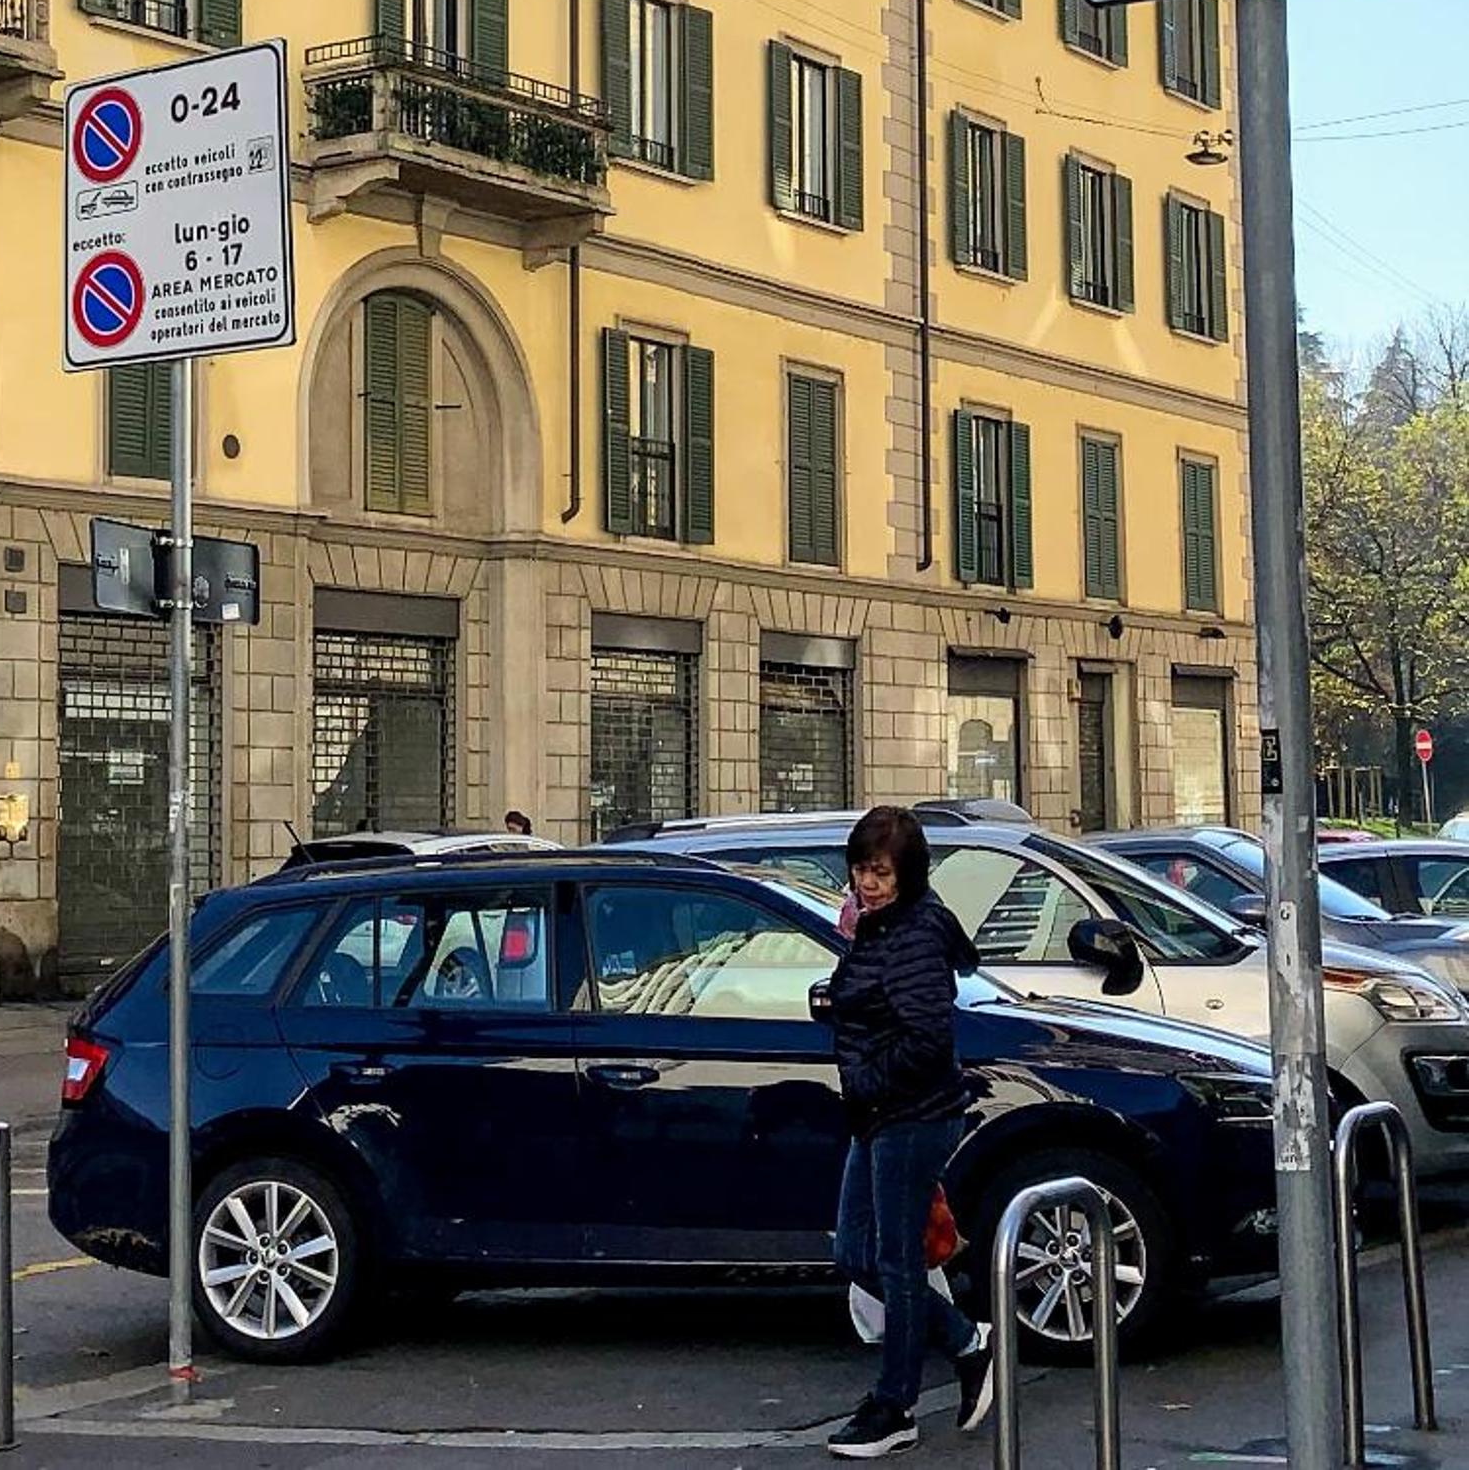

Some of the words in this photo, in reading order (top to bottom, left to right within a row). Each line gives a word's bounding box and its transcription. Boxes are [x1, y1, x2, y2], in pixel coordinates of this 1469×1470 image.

[171, 82, 240, 123] 0-24
[145, 155, 188, 175] eccetto
[194, 143, 235, 165] veicoli
[145, 181, 164, 193] con
[167, 166, 243, 190] contrassegno
[175, 214, 250, 244] lun-gio
[185, 250, 198, 271] 6
[222, 243, 243, 266] 17
[151, 280, 193, 299] AREA
[200, 267, 278, 292] MERCATO
[155, 298, 215, 319] consentito
[221, 294, 231, 310] ai
[235, 288, 276, 308] veicoli
[151, 319, 204, 343] operatori
[209, 316, 227, 332] del
[232, 310, 281, 330] mercato
